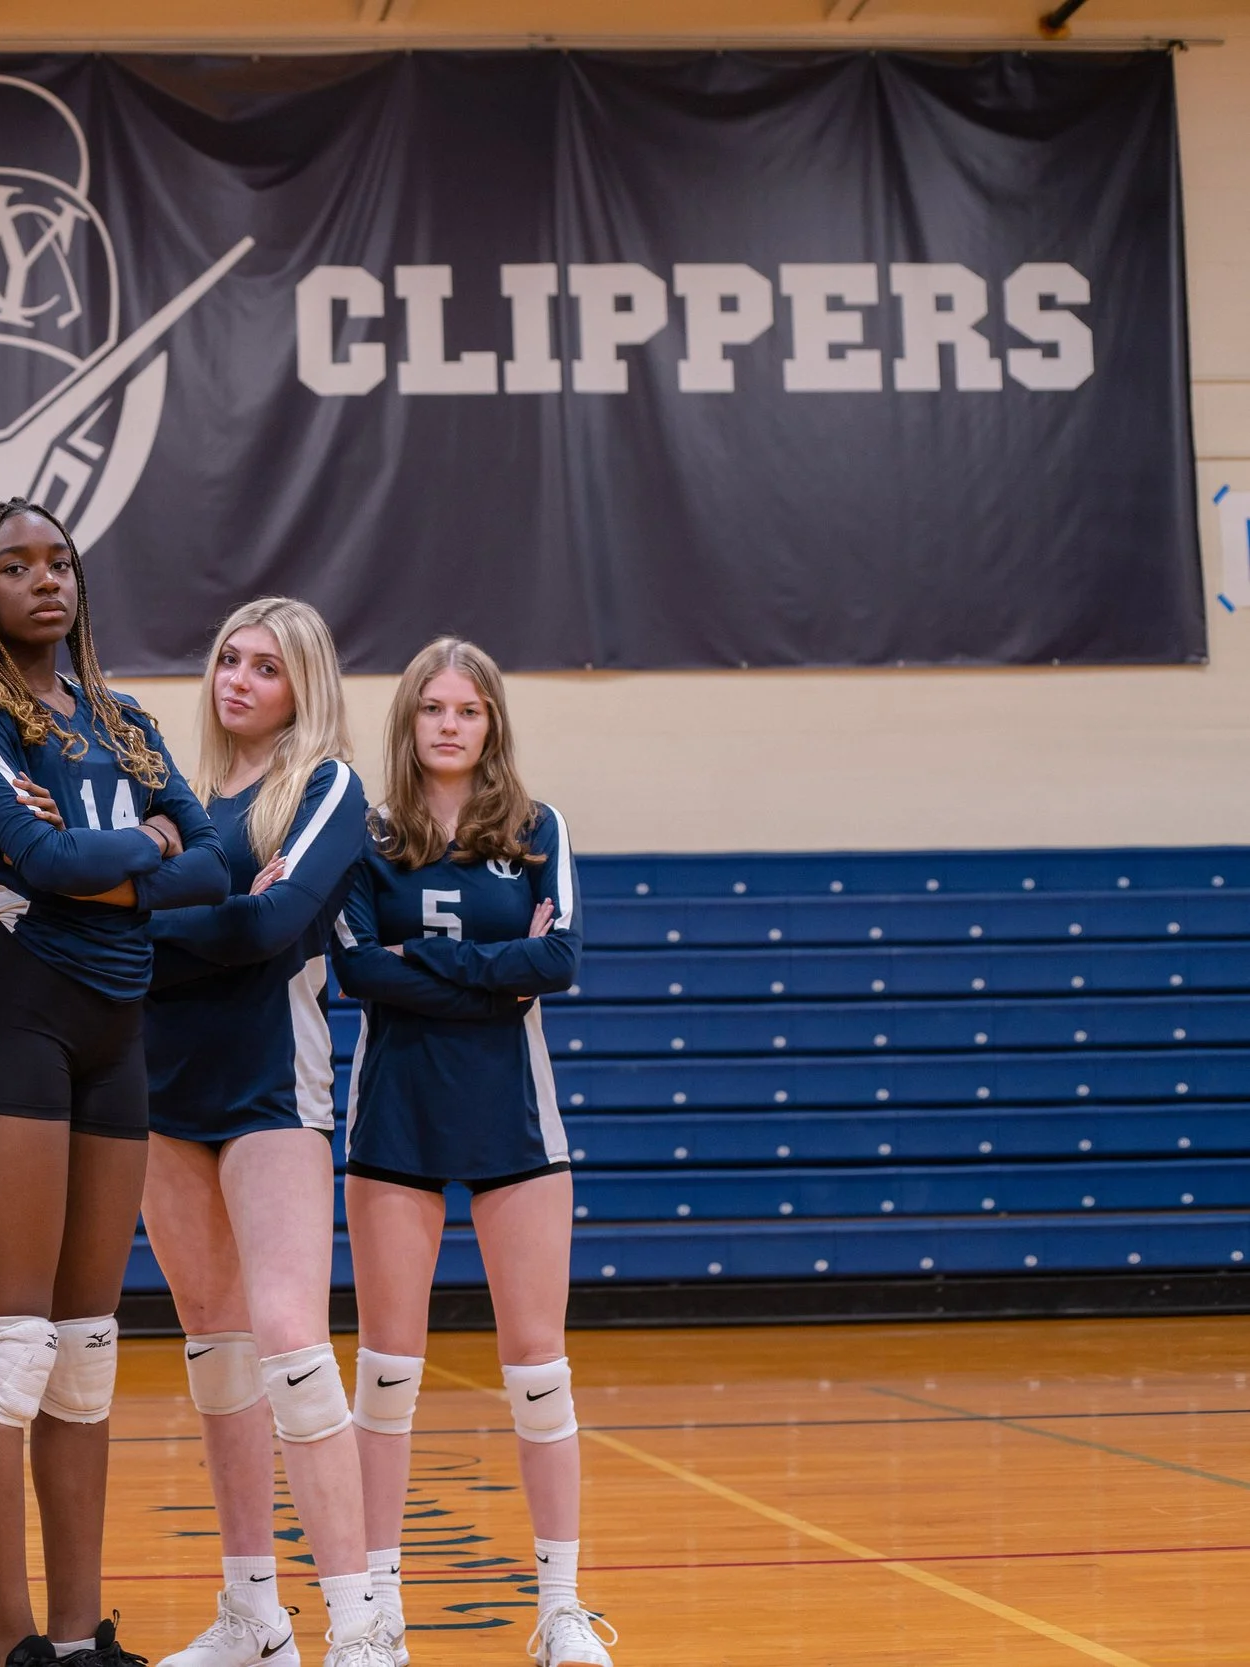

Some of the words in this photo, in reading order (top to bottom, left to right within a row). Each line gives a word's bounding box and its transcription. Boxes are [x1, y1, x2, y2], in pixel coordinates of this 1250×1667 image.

[295, 262, 1094, 396] CLIPPERS
[79, 779, 140, 831] 14
[422, 888, 463, 942] 5
